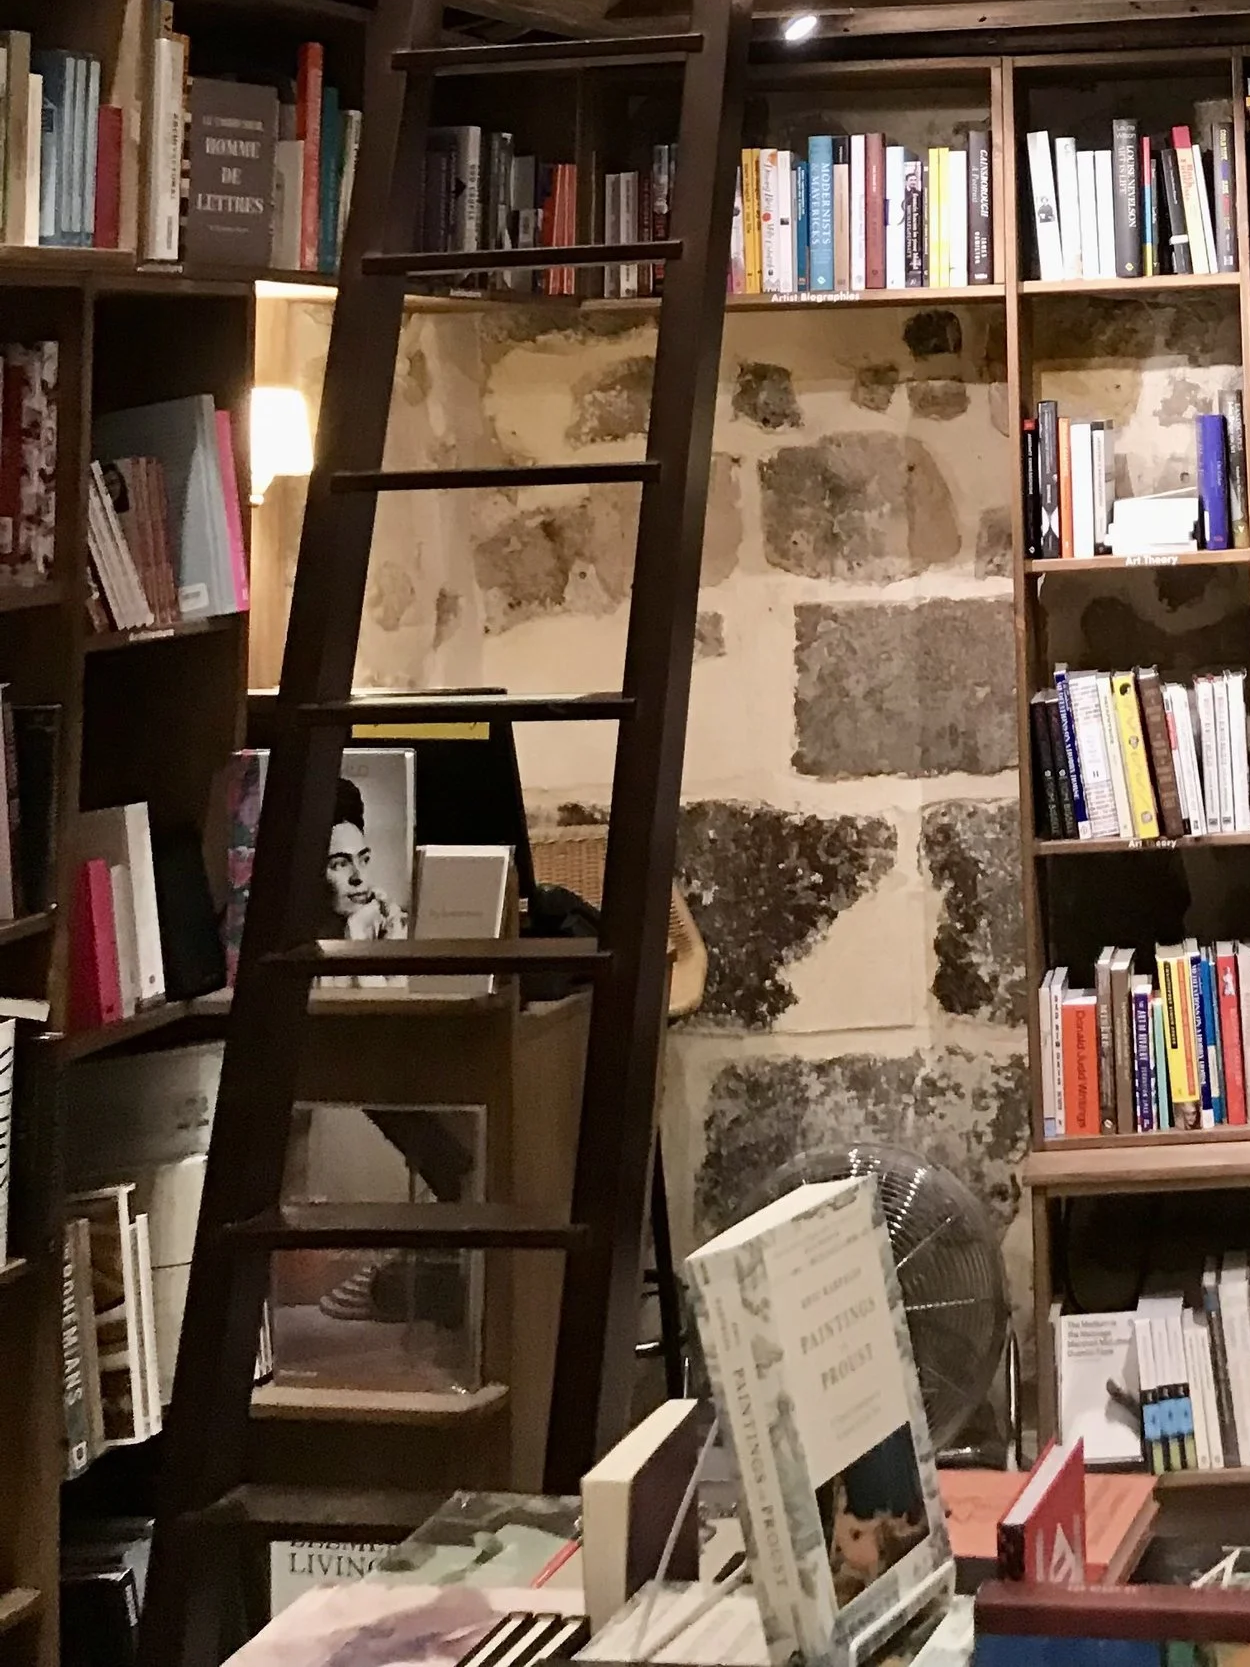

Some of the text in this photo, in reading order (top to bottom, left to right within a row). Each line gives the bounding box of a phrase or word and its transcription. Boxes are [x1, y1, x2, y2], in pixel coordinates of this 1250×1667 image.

[221, 166, 242, 184] DE
[979, 149, 988, 217] GAINSBOROUGH
[1126, 145, 1136, 227] LOUISE NEVELSON
[196, 193, 264, 213] LETTRES
[808, 175, 821, 245] MAVERICKS
[818, 162, 833, 244] MODERNISTS
[771, 291, 860, 304] Artist Biographies
[1234, 402, 1243, 450] LANDSCAPES
[1125, 555, 1178, 566] Art Theory
[1128, 839, 1177, 849] Art eory
[1073, 1010, 1089, 1127] Donald Judd Writings
[800, 1296, 876, 1355] PAINTINGS
[820, 1342, 875, 1392] PROUST
[732, 1366, 788, 1588] PAINTINGS PROUST
